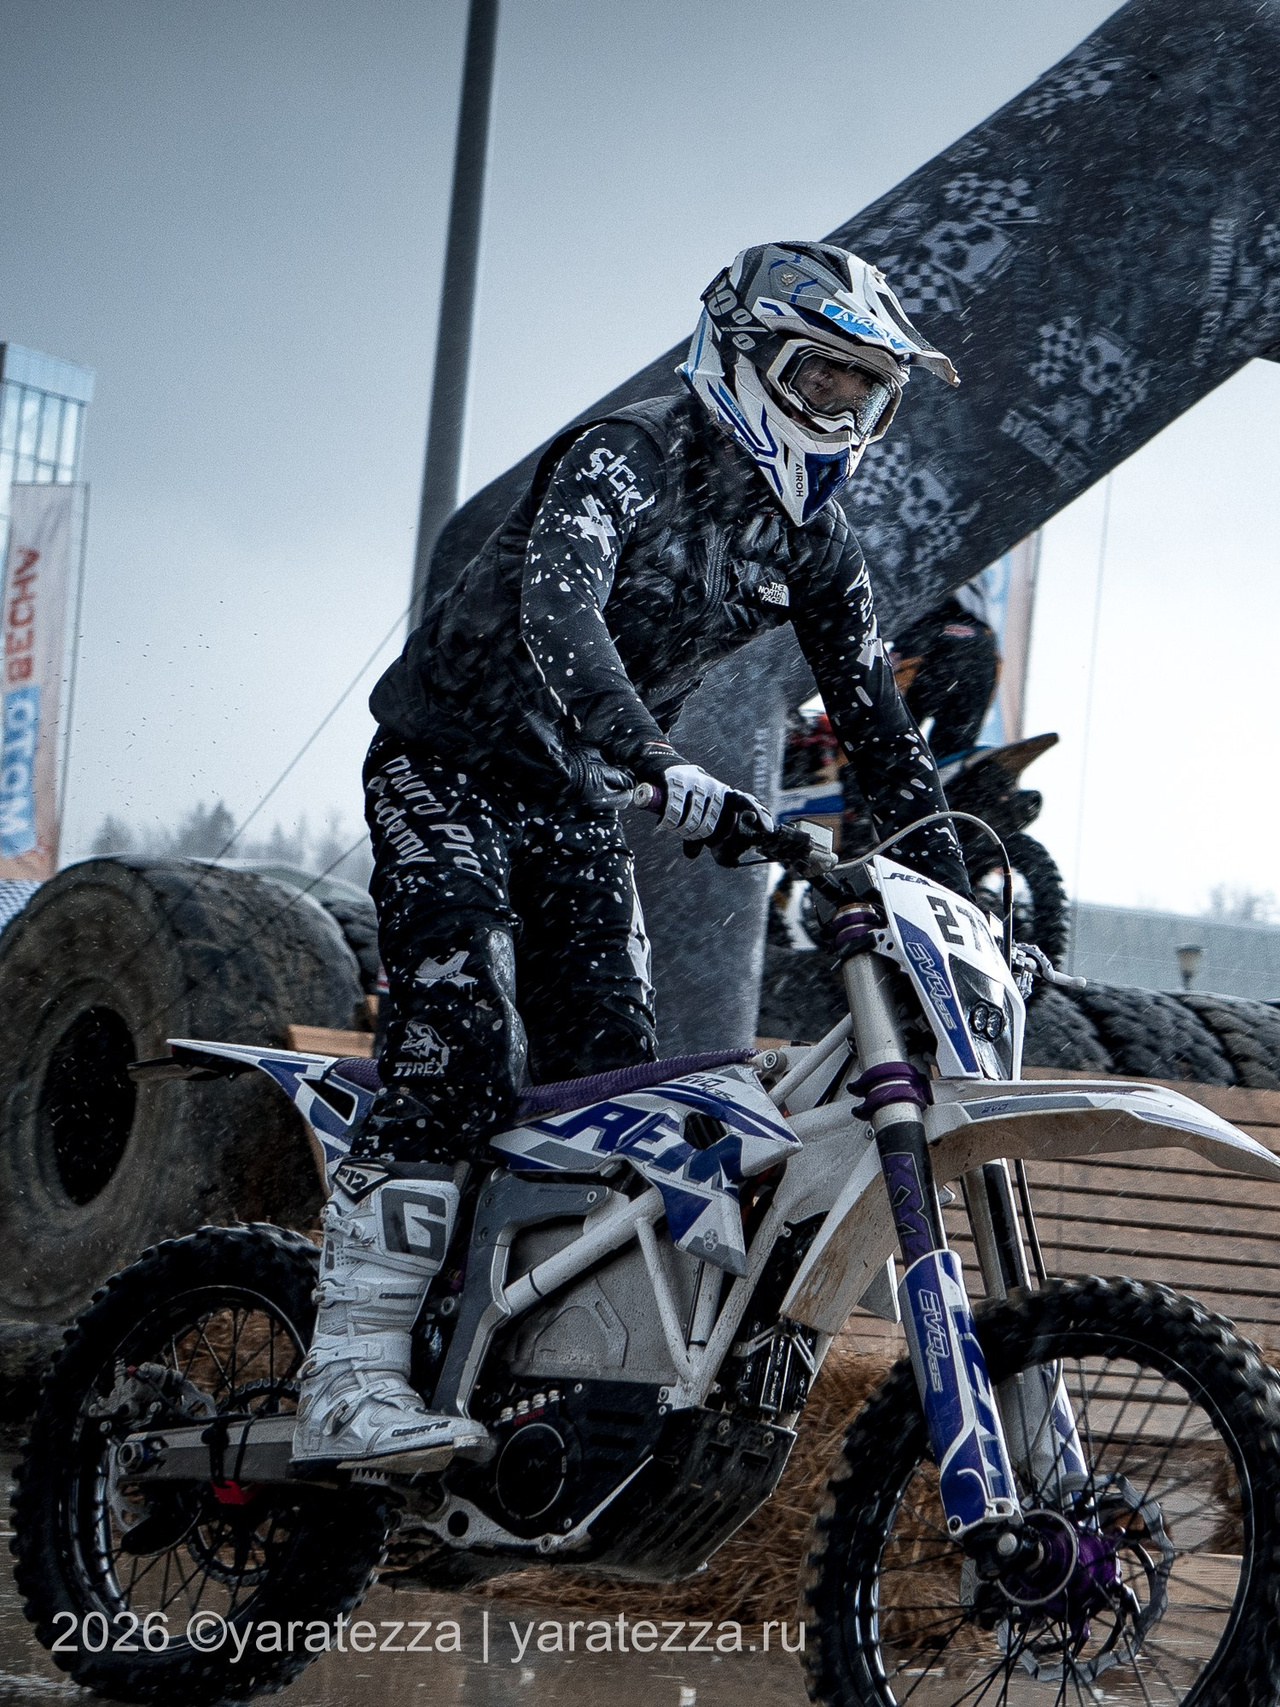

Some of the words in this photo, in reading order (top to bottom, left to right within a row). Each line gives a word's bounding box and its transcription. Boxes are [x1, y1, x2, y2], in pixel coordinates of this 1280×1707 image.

[795, 463, 804, 498] AIROH
[758, 585, 783, 599] NORTH
[770, 581, 786, 592] THE
[761, 594, 783, 604] FACE
[428, 823, 485, 878] Pro
